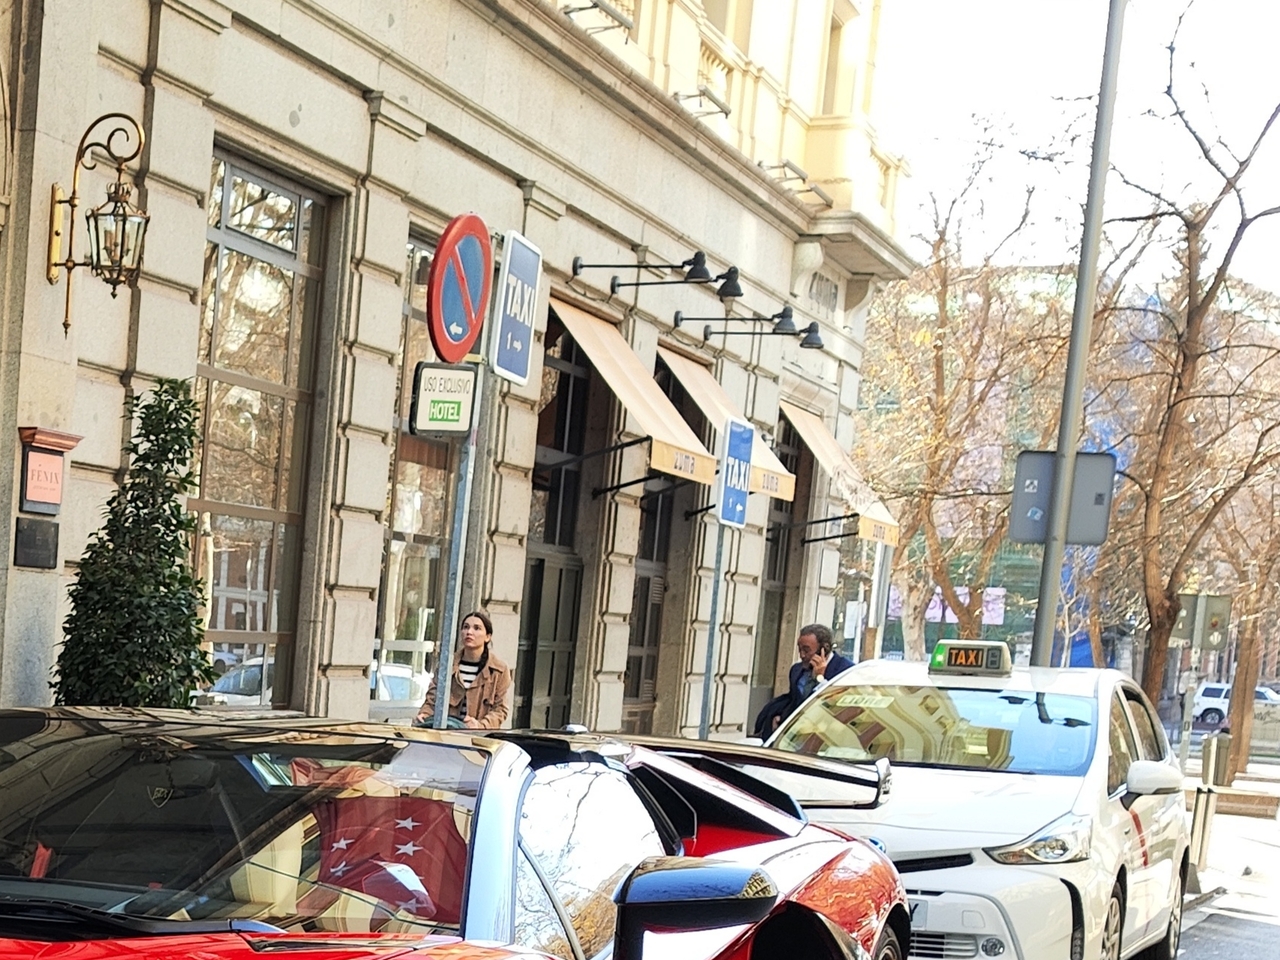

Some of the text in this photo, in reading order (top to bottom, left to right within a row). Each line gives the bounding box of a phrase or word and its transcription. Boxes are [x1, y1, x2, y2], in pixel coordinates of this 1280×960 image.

[506, 273, 535, 328] TAXI
[424, 376, 438, 392] USO
[430, 402, 460, 420] HOTEL
[727, 456, 750, 492] TAXI
[950, 649, 983, 666] TAXI
